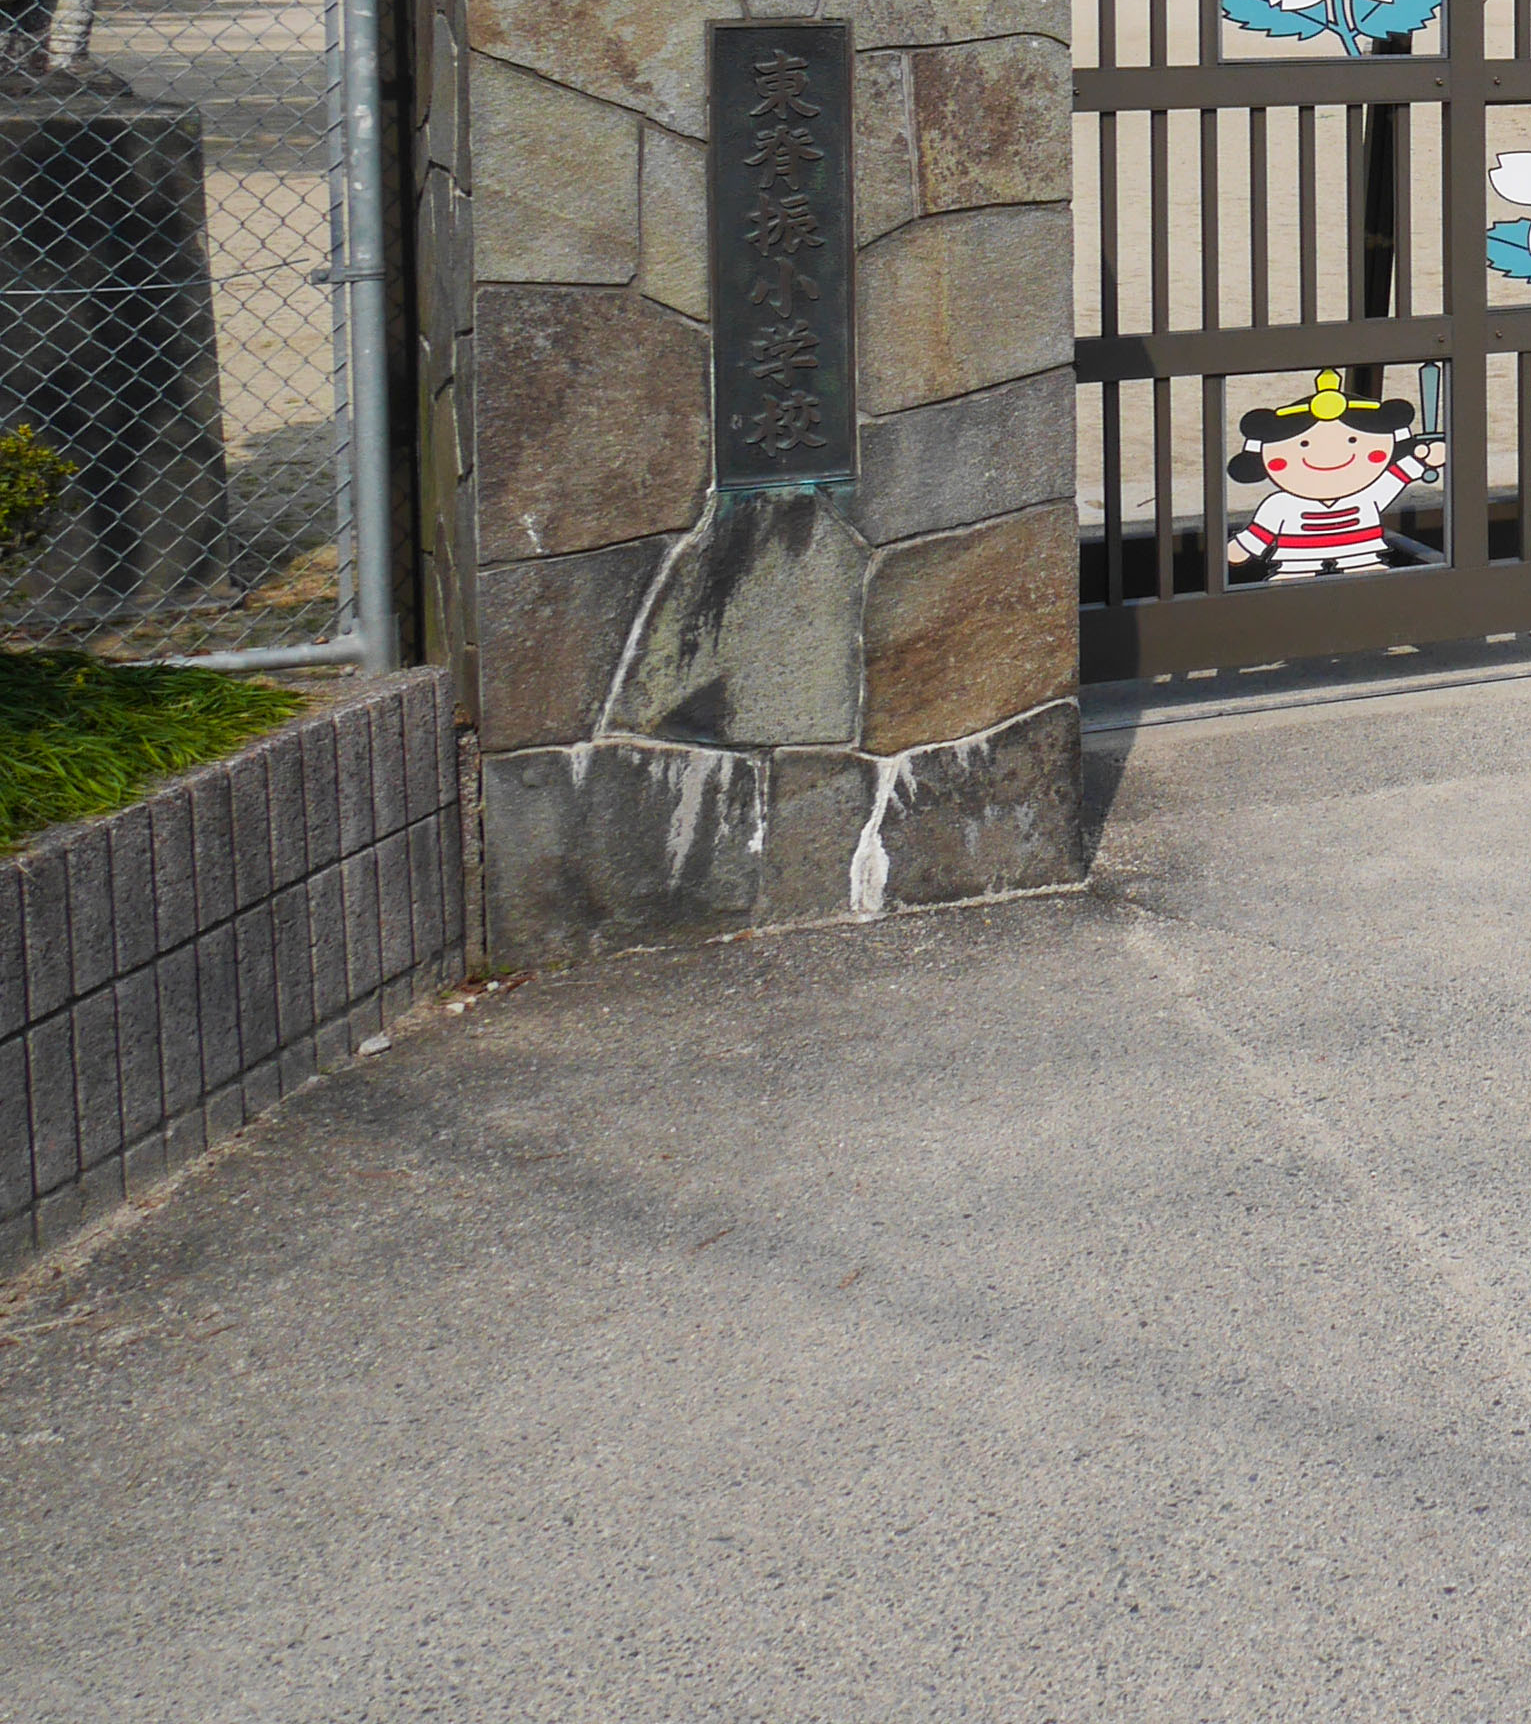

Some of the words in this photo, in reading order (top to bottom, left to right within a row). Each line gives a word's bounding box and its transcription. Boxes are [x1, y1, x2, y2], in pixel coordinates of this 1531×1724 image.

[743, 49, 828, 460] 東脊振小学校
